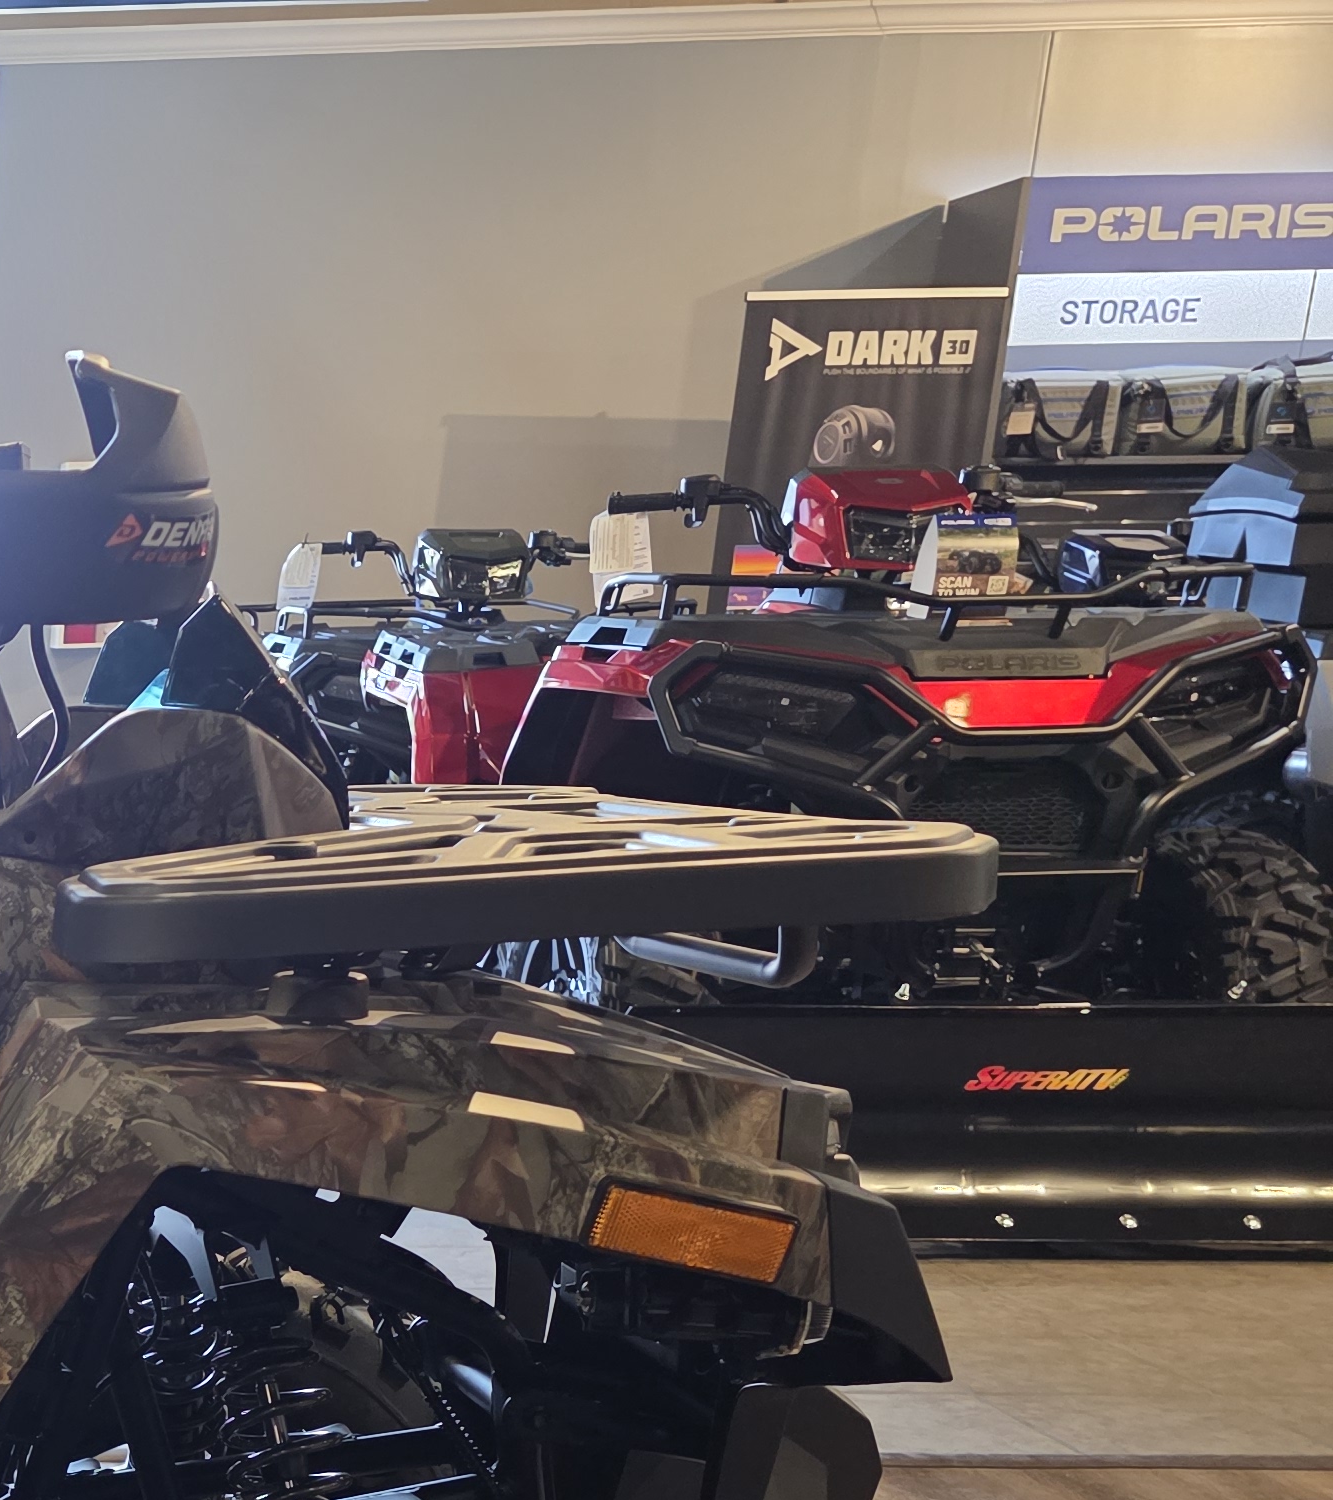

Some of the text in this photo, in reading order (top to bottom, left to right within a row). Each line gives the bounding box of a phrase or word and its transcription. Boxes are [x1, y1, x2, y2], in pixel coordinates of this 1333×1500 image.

[1049, 203, 1333, 243] POLARIS
[1059, 297, 1201, 326] STORAGE
[824, 329, 937, 366] DARK
[938, 576, 973, 588] SCAN
[937, 651, 1082, 672] POLARIS
